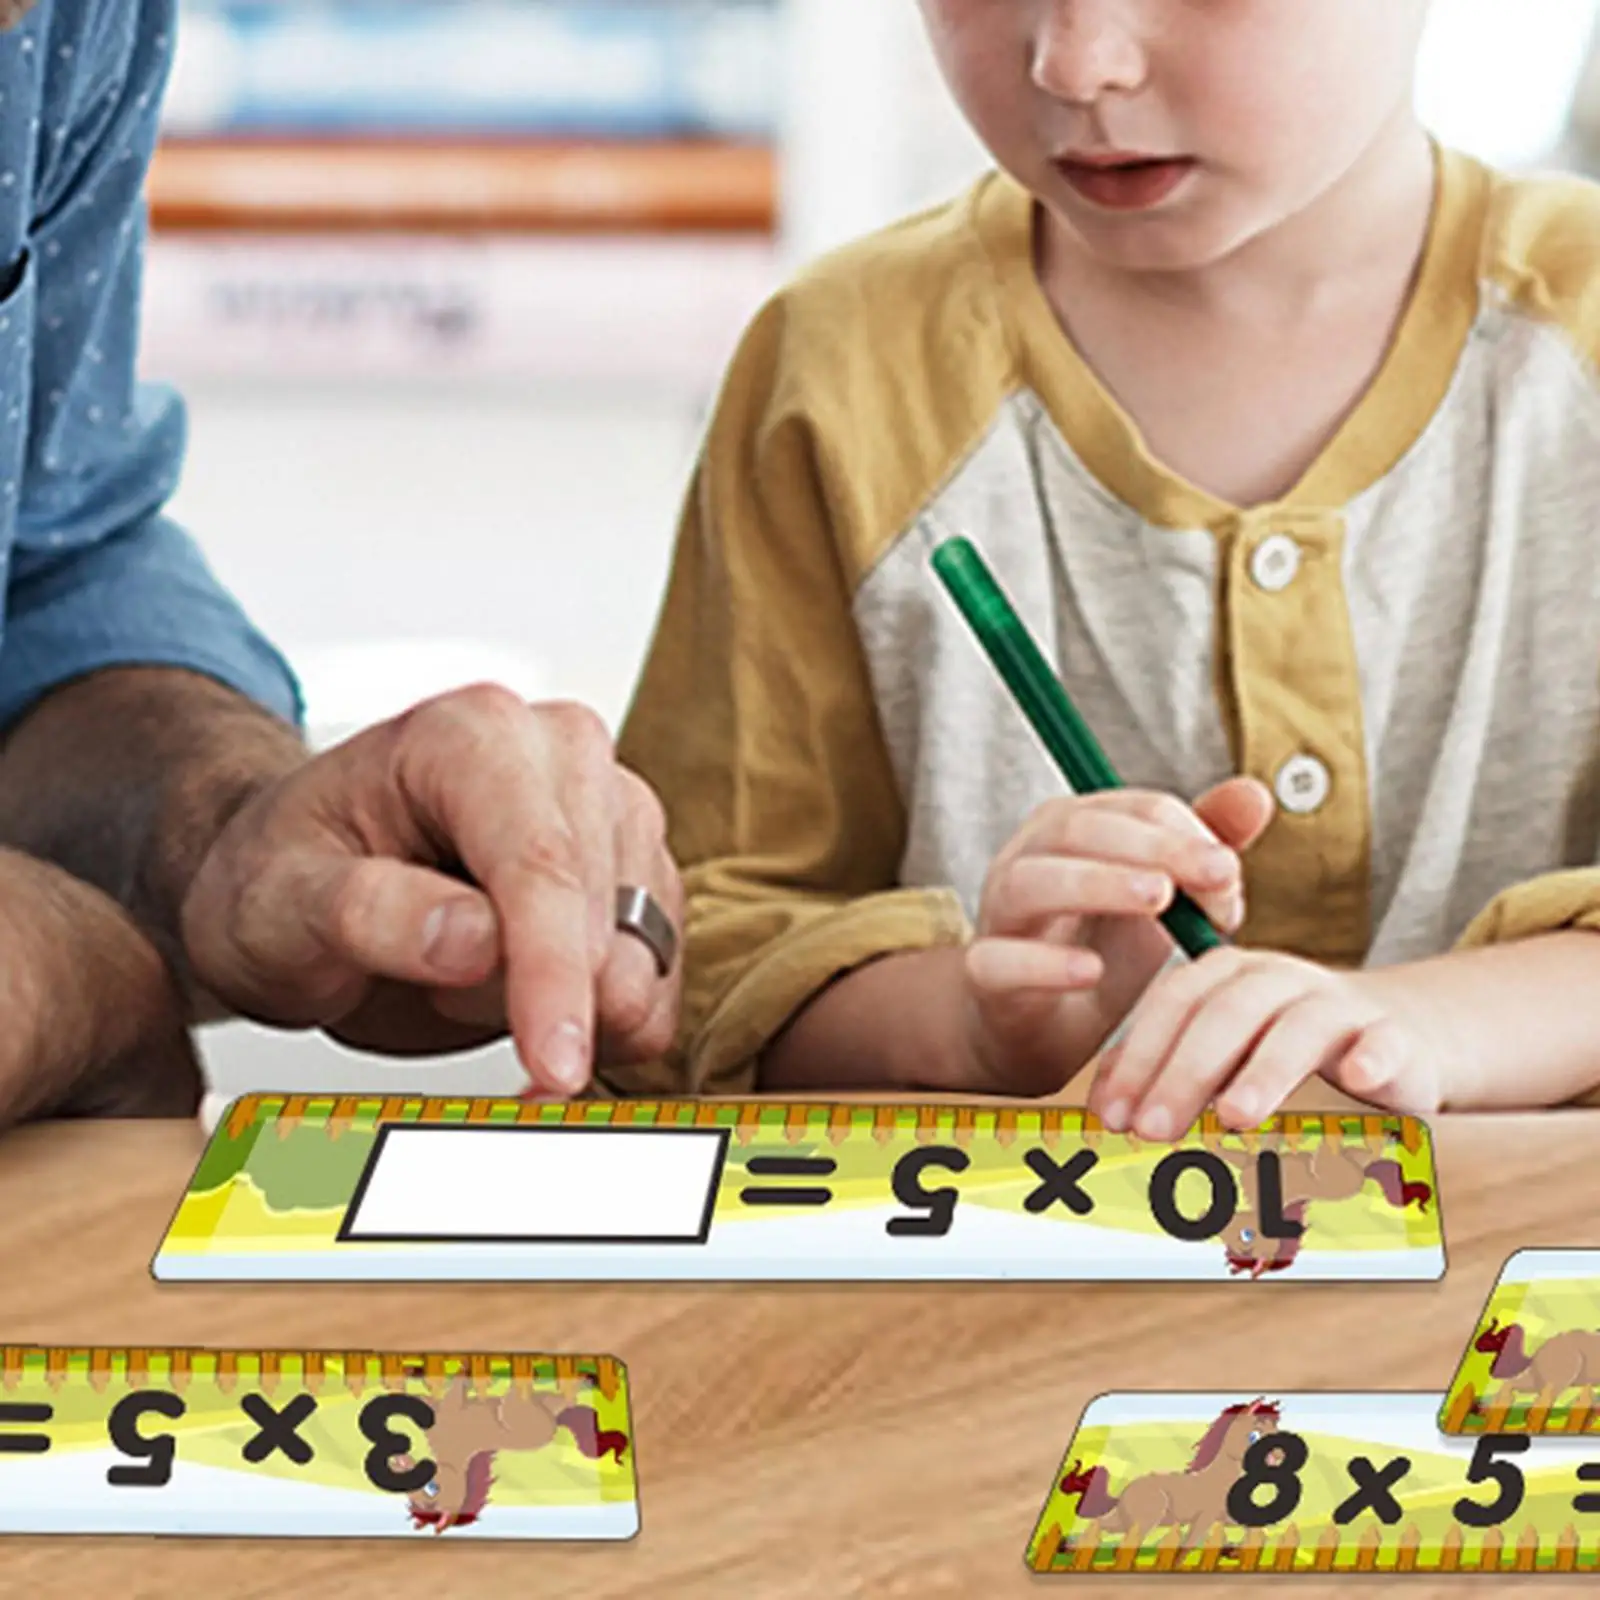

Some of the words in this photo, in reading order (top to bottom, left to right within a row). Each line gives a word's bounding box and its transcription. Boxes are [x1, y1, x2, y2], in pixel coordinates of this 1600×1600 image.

[740, 1156, 837, 1206] =
[886, 1145, 970, 1236] 5
[1148, 1149, 1305, 1241] 10
[107, 1390, 186, 1486] 5
[358, 1393, 437, 1493] 3
[1226, 1431, 1309, 1527] 8
[1453, 1433, 1532, 1527] 5
